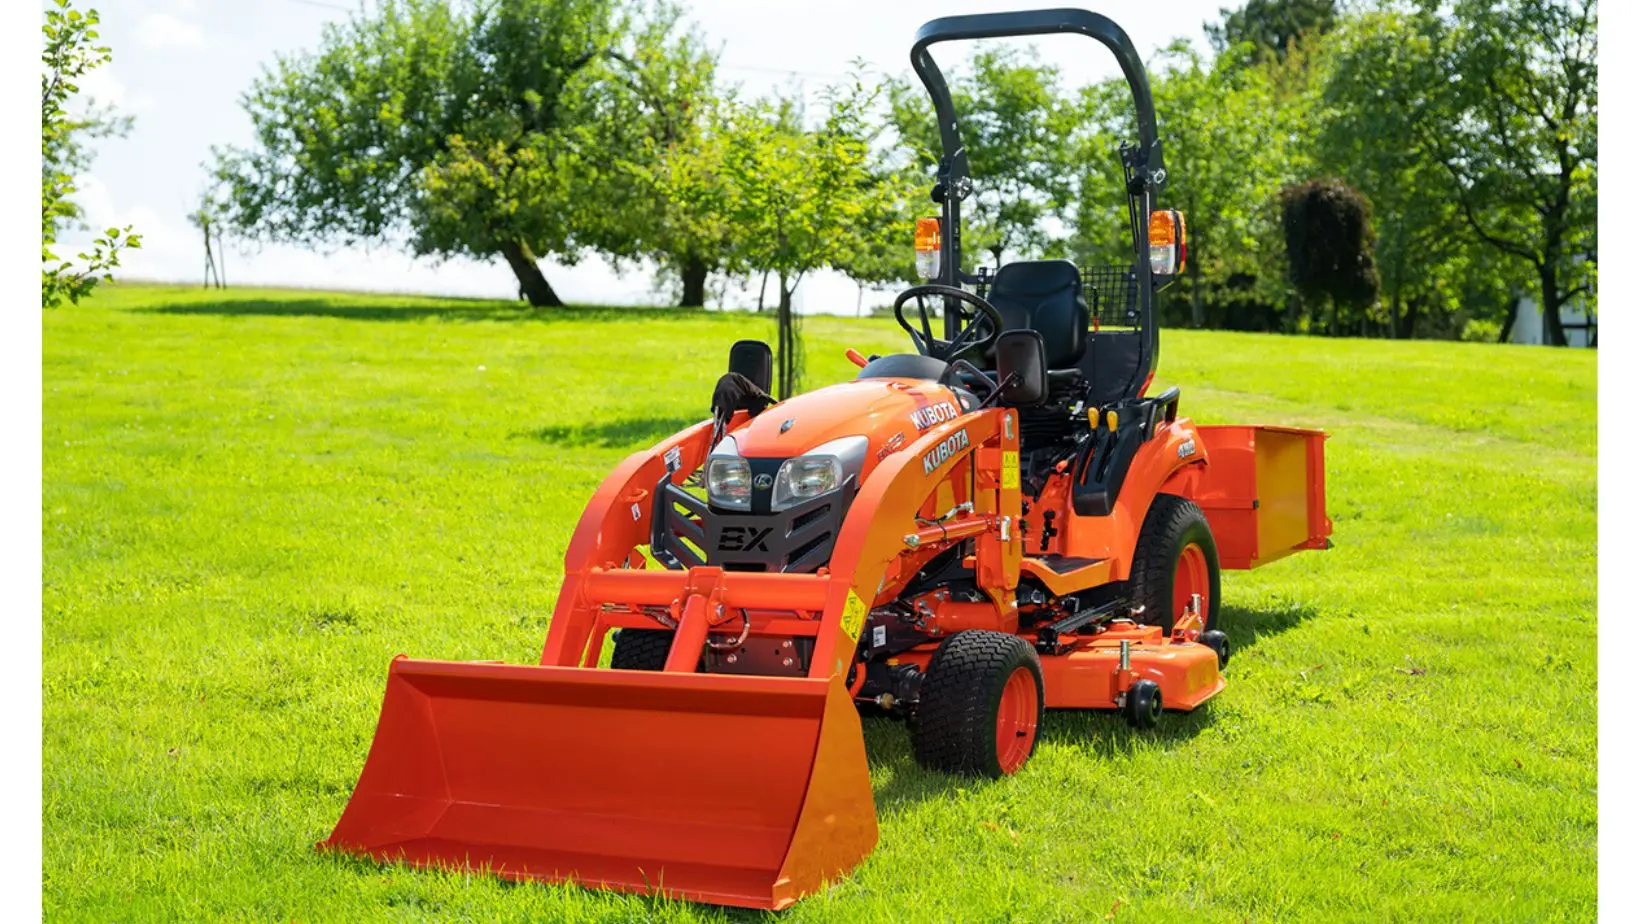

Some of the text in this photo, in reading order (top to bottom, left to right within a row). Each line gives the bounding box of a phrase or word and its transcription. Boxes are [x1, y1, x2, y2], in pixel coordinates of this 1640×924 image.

[911, 402, 958, 430] KUBOTA
[923, 428, 969, 475] KUBOTA
[718, 526, 774, 552] BX
